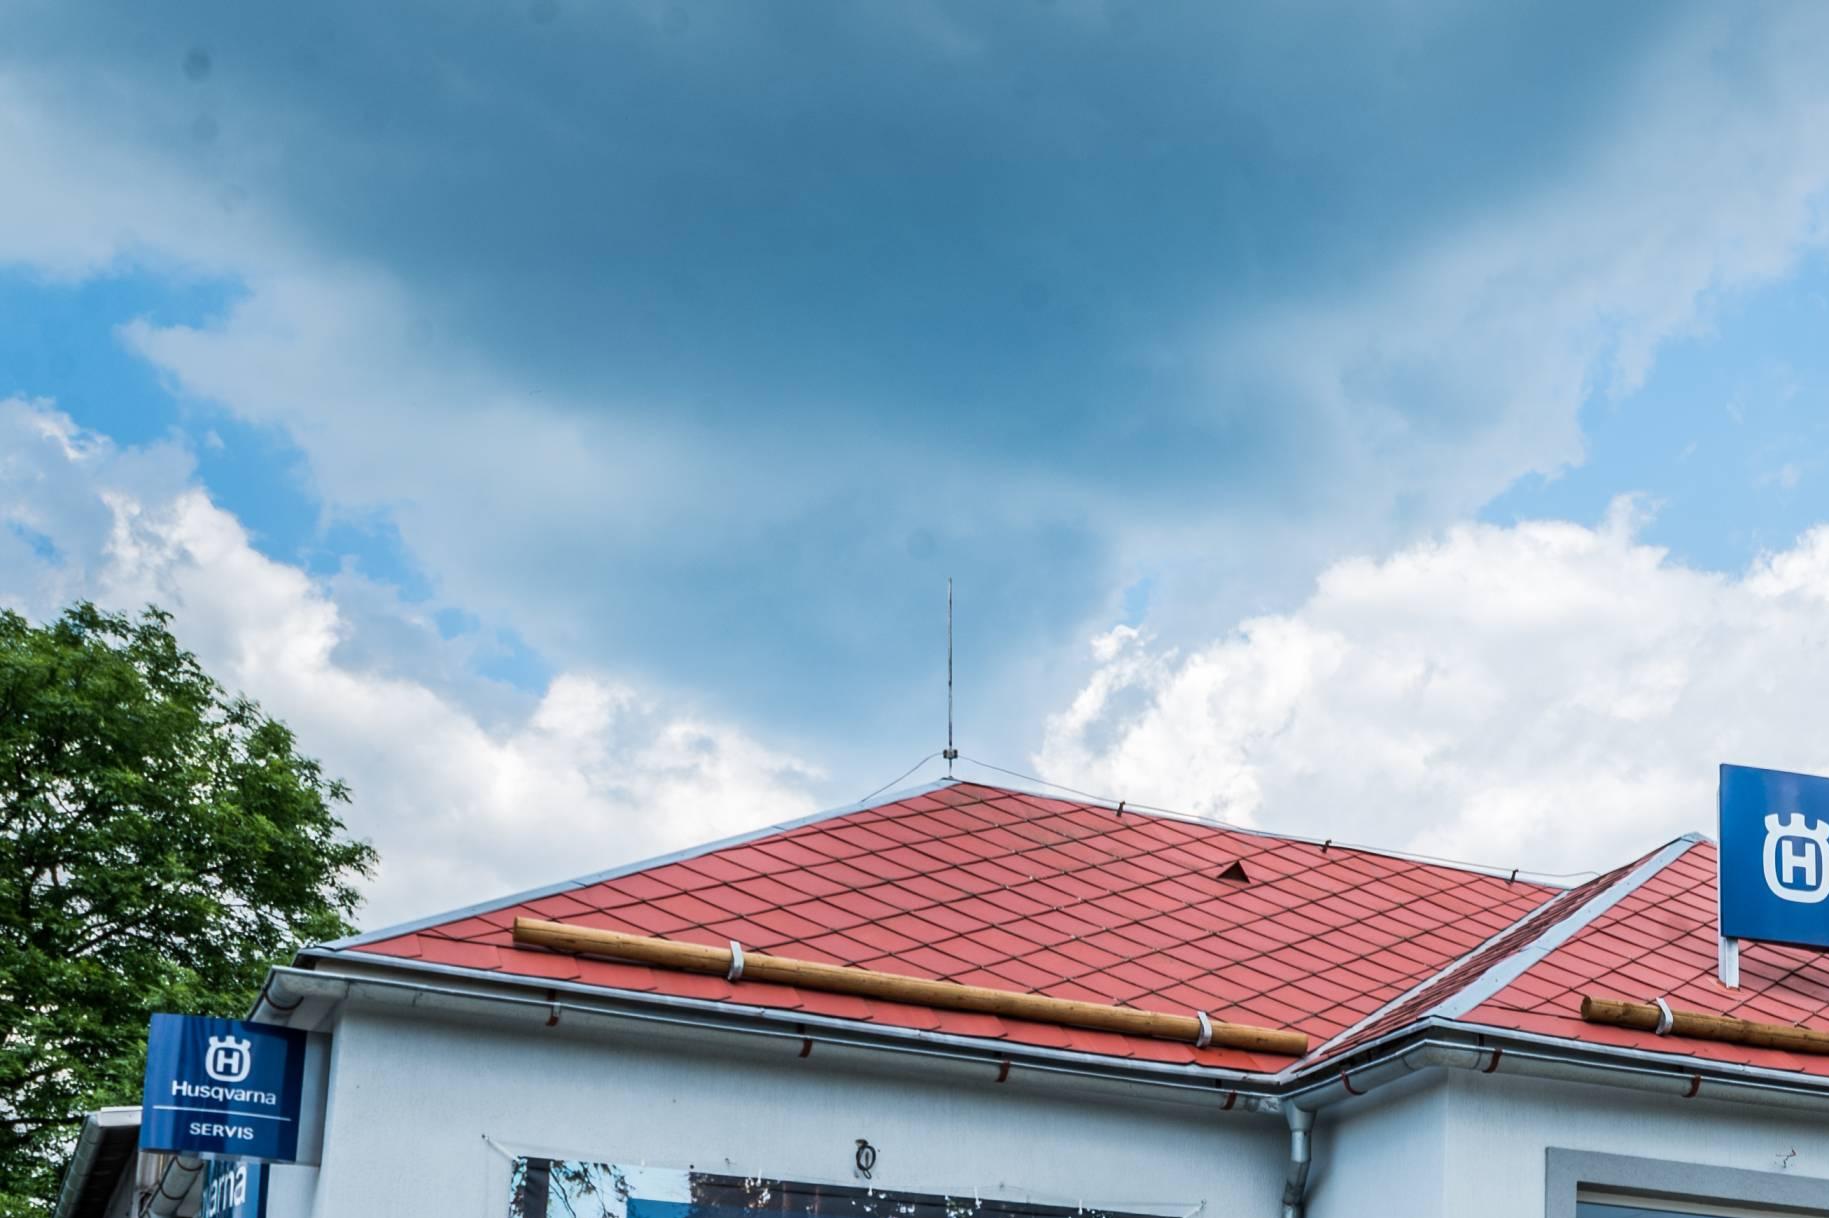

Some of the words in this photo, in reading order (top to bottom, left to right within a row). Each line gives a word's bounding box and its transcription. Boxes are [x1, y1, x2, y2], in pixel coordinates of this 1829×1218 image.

[171, 1080, 277, 1105] Husqvarna
[189, 1122, 255, 1140] SERVIS
[204, 1165, 247, 1218] arna
